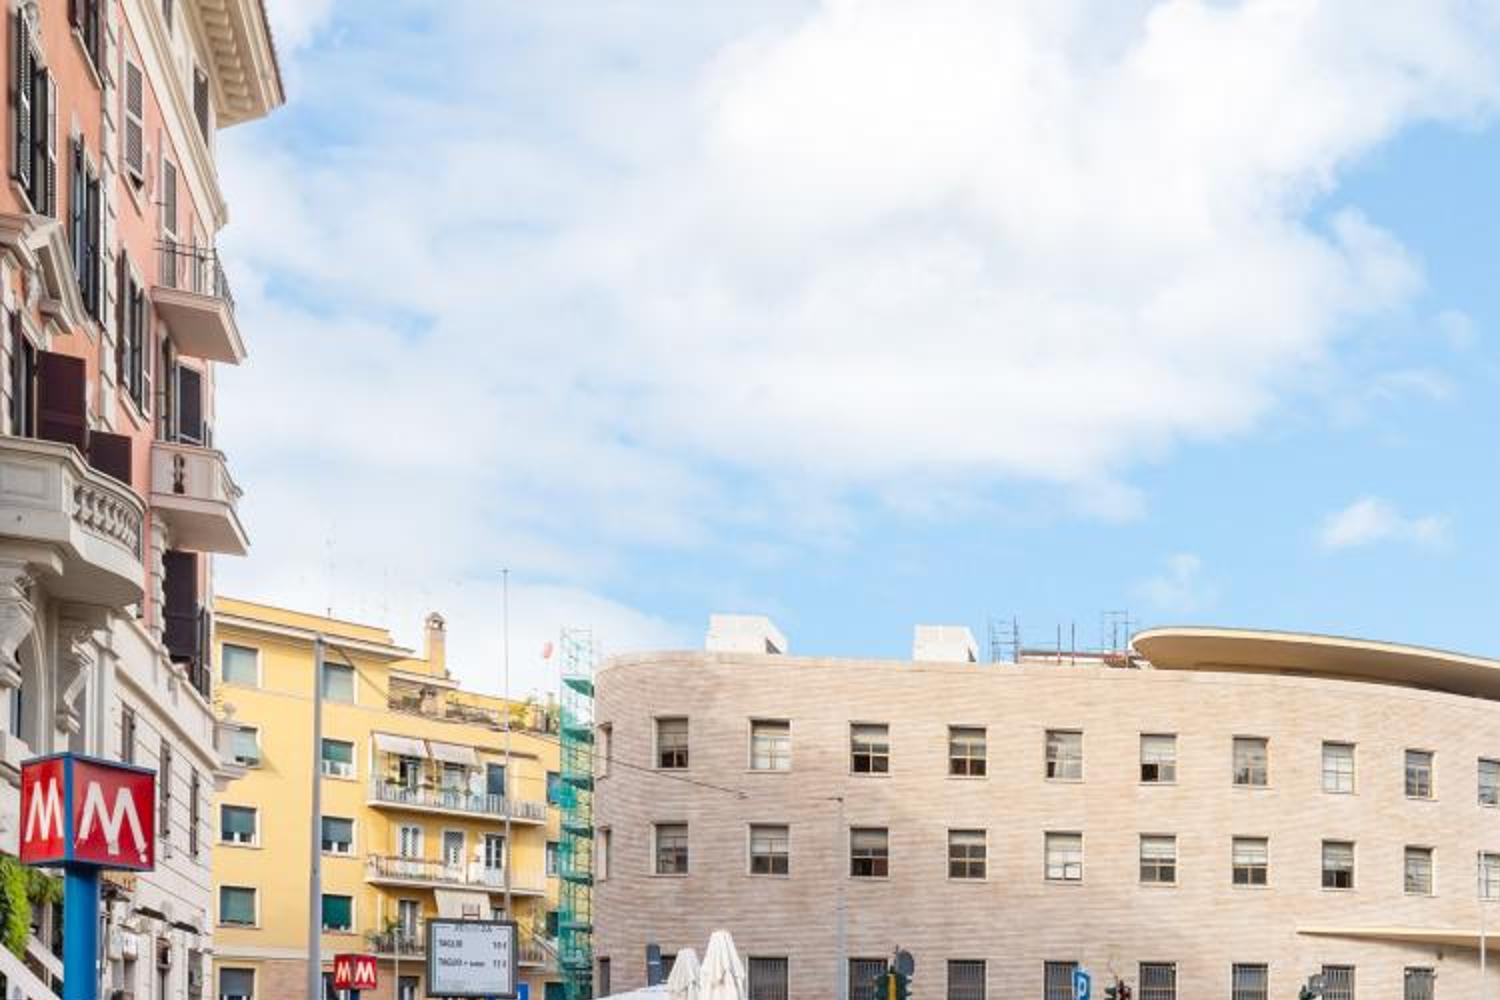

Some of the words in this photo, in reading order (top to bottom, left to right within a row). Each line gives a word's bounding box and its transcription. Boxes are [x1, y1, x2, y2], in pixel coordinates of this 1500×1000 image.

[25, 778, 64, 842] M
[80, 781, 147, 861] M
[336, 960, 351, 983] M
[355, 960, 376, 983] M
